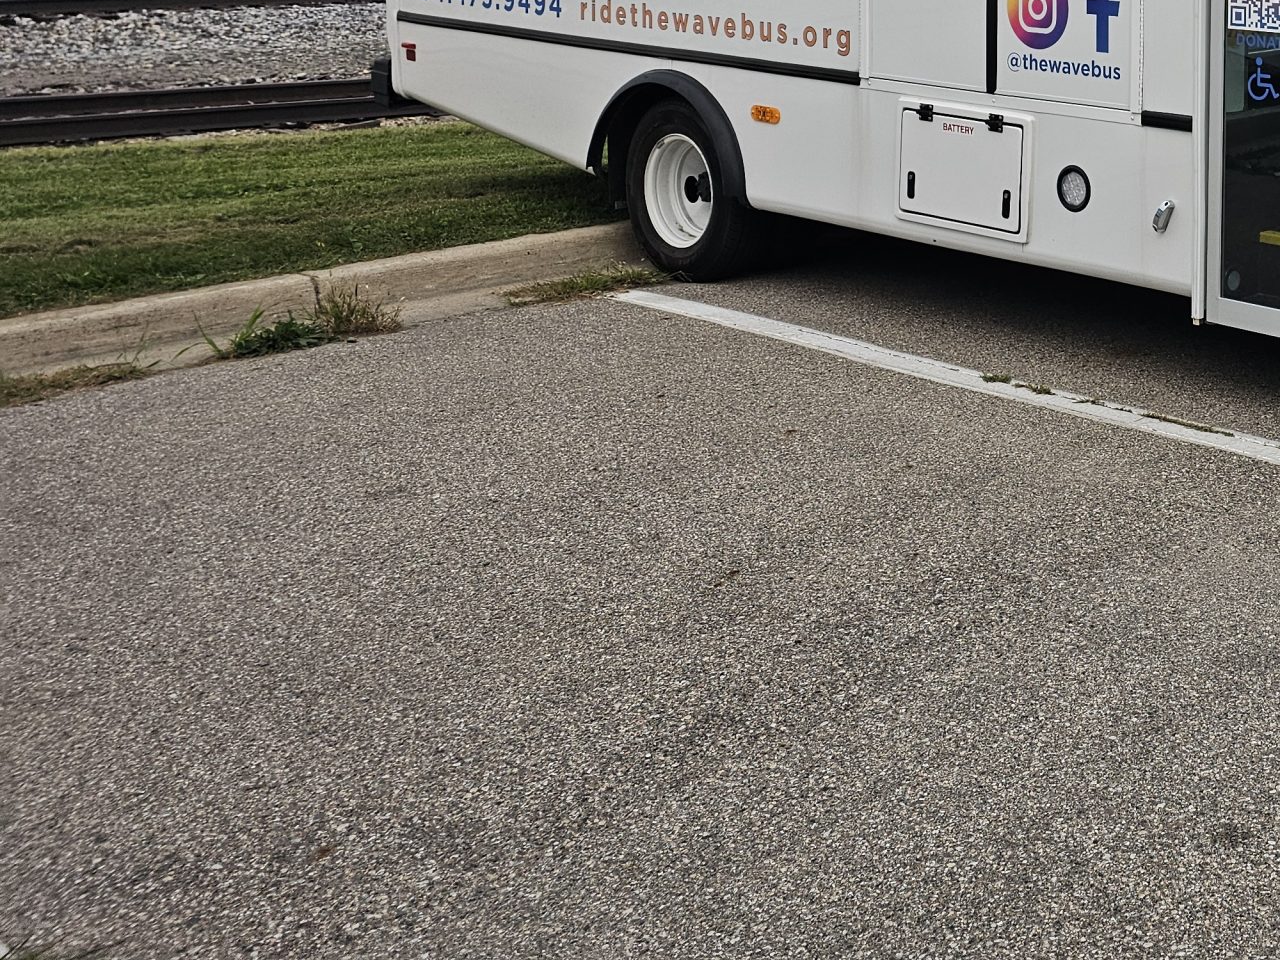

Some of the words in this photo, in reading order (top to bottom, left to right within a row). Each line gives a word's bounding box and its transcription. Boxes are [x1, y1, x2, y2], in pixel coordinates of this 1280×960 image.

[580, 0, 852, 57] ridethewavebus.org
[1007, 51, 1121, 81] @thewavebus
[943, 122, 974, 135] BATTERY
